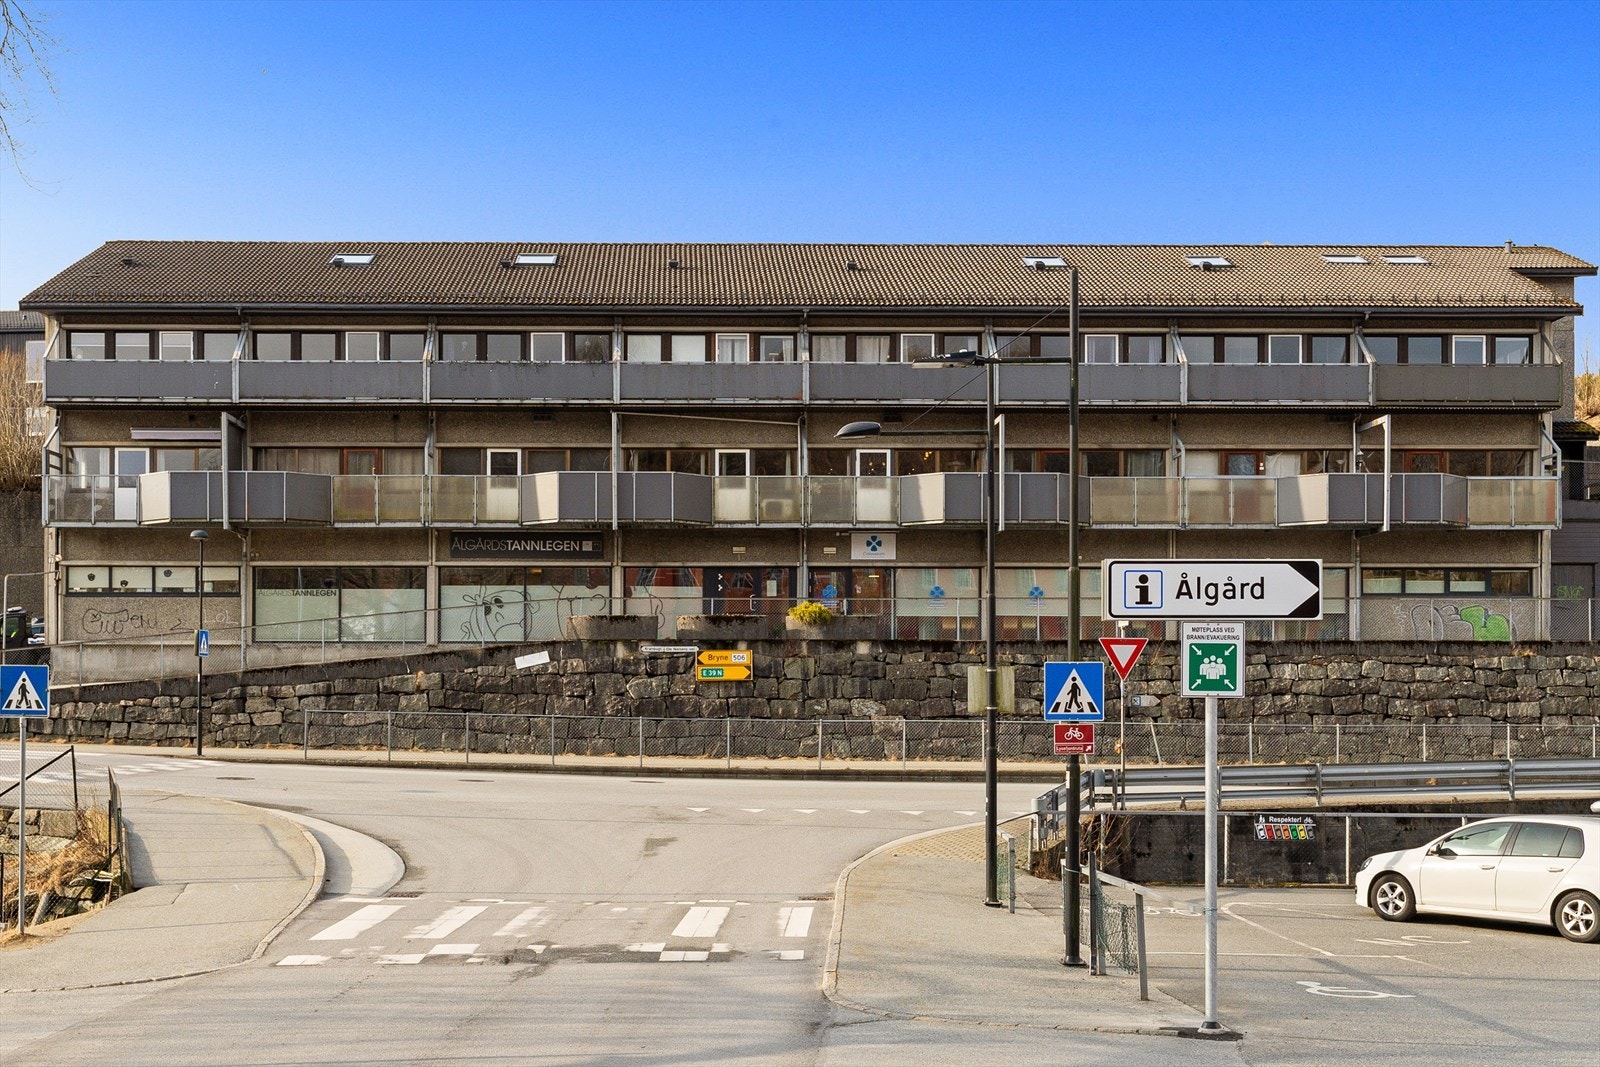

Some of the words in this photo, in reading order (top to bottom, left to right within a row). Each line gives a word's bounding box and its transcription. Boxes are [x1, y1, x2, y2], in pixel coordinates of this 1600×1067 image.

[452, 537, 580, 551] ÅLGÅRDSTANNLEGEN
[1175, 572, 1265, 606] Ålgård
[708, 653, 729, 662] Bryne
[733, 653, 746, 661] 506
